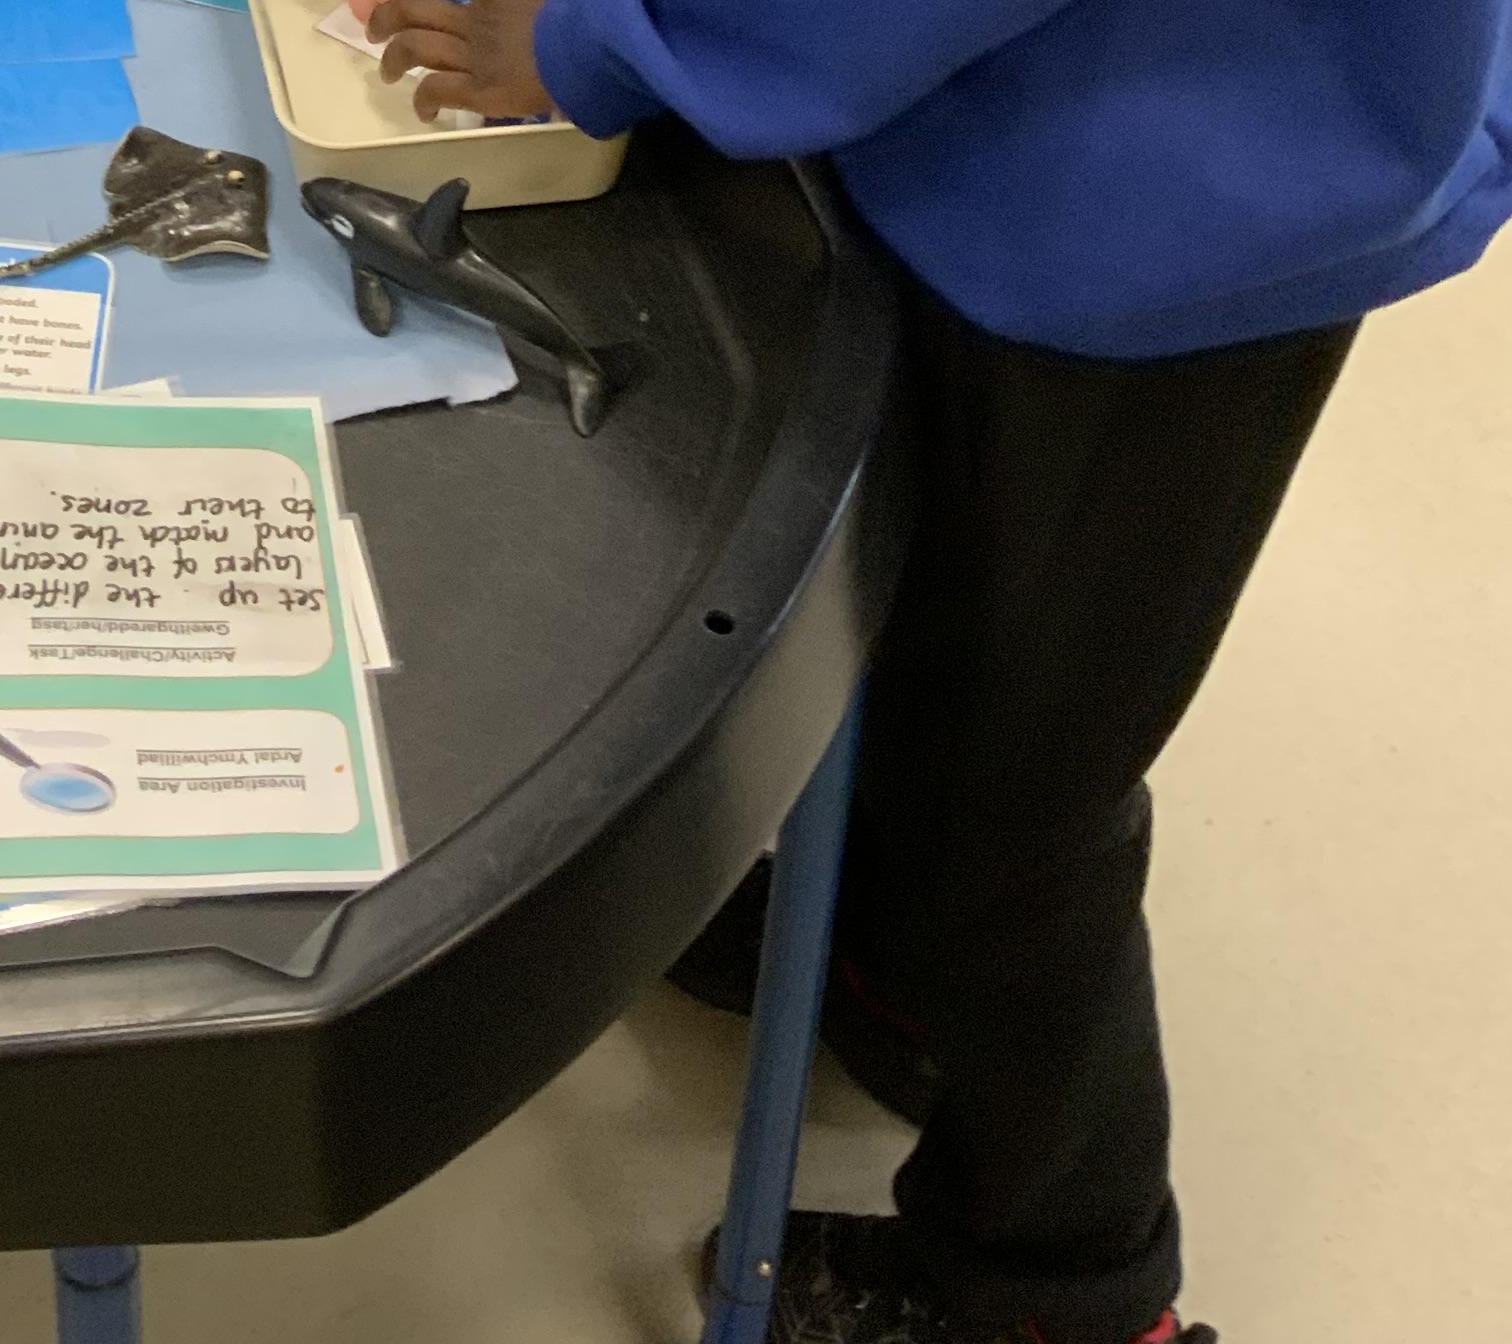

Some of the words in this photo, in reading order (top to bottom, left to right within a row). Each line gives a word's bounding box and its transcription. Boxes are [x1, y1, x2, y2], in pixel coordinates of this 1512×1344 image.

[9, 316, 39, 327] have
[43, 317, 83, 331] bones.
[8, 334, 21, 346] of
[24, 335, 56, 346] their
[59, 338, 91, 350] head
[12, 348, 53, 360] water.
[177, 496, 263, 518] their
[280, 496, 314, 516] to
[69, 521, 123, 548] the
[137, 518, 227, 545] match
[253, 522, 313, 548] and
[102, 554, 154, 577] the
[172, 547, 196, 578] of
[213, 545, 301, 579] layers
[104, 582, 160, 609] the
[217, 579, 257, 609] up
[277, 587, 324, 610] Set
[136, 749, 246, 766] Ymchwilliad
[253, 749, 301, 764] Ardal
[137, 776, 179, 794] Area
[186, 774, 305, 793] Investigation
